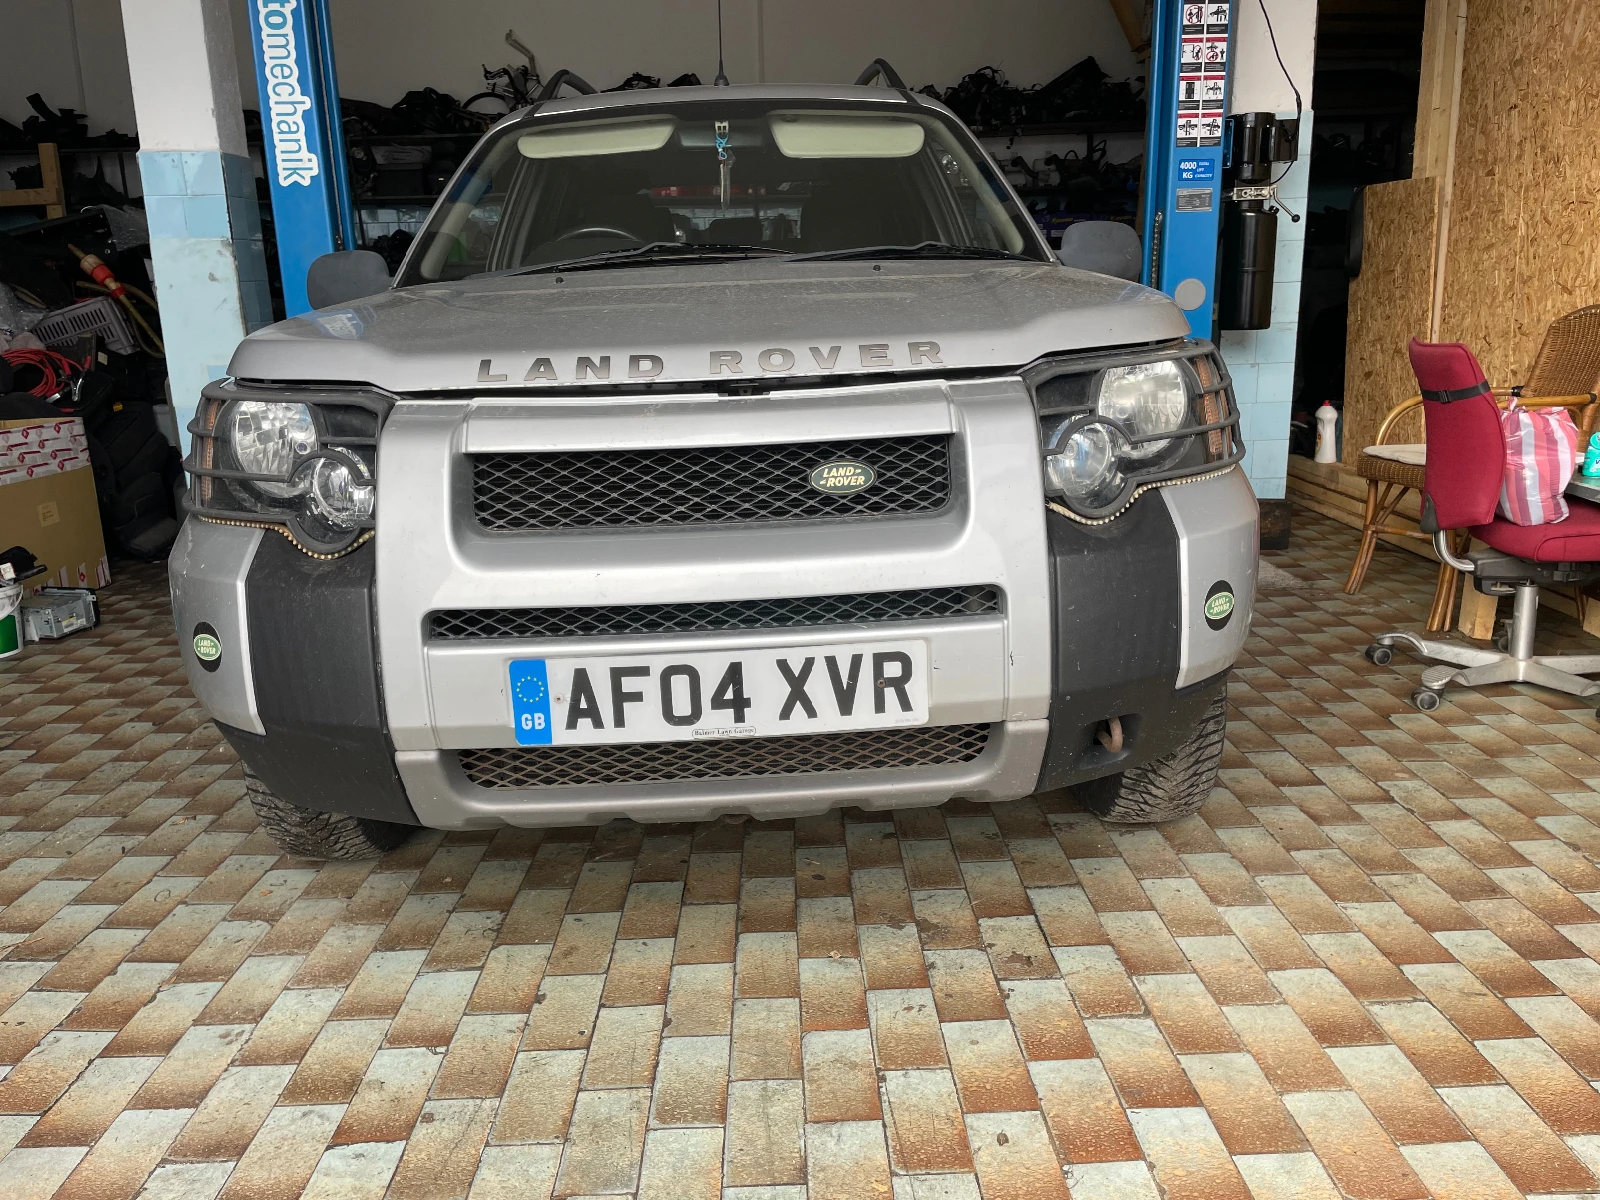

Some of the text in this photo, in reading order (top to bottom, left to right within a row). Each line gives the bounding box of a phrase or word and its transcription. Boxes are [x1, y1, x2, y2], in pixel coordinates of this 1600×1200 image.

[477, 341, 944, 382] LAND ROVER
[565, 651, 914, 731] AF04 XVR
[521, 713, 546, 730] GB
